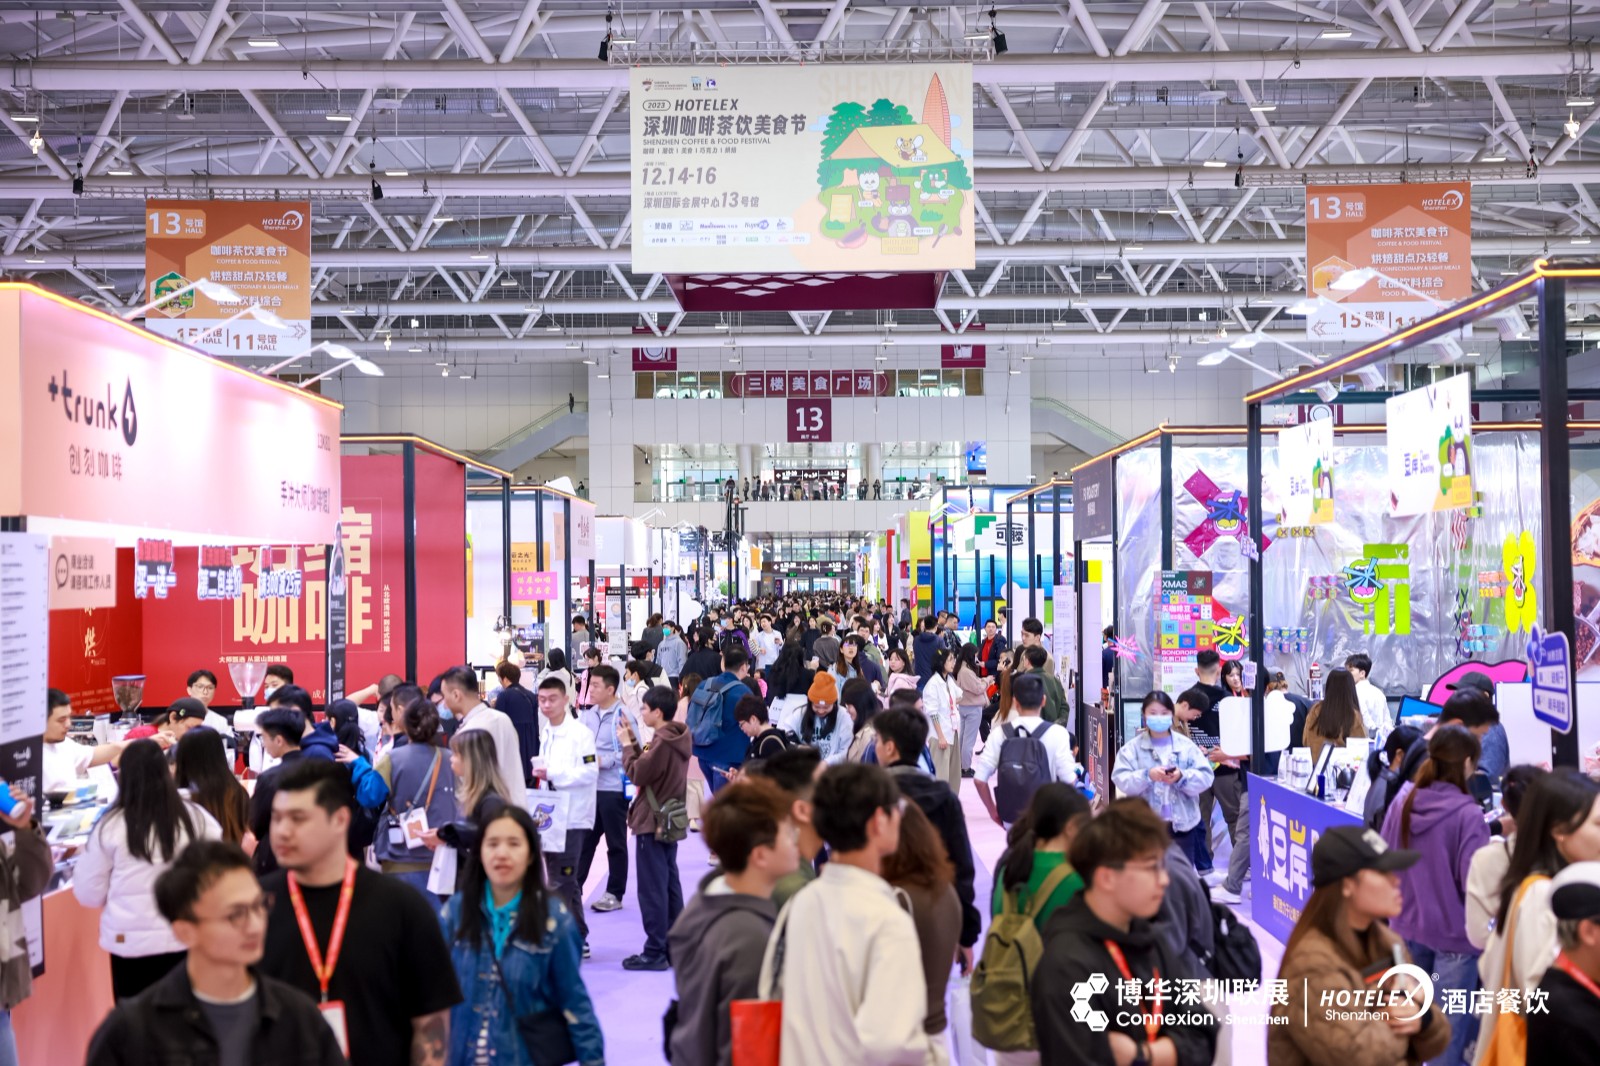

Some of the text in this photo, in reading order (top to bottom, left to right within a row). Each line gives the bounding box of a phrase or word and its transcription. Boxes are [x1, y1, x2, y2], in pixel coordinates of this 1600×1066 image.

[674, 99, 739, 111] HOTELEX
[643, 114, 807, 137] 深圳咖啡茶饮美食节
[741, 137, 771, 145] FESTIVAL
[642, 167, 717, 185] 12.14-16
[643, 192, 760, 208] 深圳国际会展中心13号馆
[1309, 196, 1364, 220] 13 号馆
[1421, 198, 1457, 207] HOTELEX
[149, 212, 204, 235] 13 号馆
[262, 218, 298, 226] HOTELEX
[1370, 226, 1449, 239] 咖啡茶饮美食节
[210, 245, 288, 256] 咖啡茶饮美食节
[1371, 252, 1449, 264] 烘焙甜点及轻餐
[210, 271, 288, 282] 烘焙甜点及轻餐
[1364, 311, 1385, 321] 号馆
[233, 334, 278, 350] 11 号馆
[748, 375, 873, 391] 三楼美食广场
[796, 407, 824, 431] 13
[69, 443, 122, 481] 创刻咖啡
[71, 554, 94, 570] 商业洽谈
[70, 574, 111, 590] 请咨询工作人员
[135, 564, 177, 599] 买一送一
[198, 565, 243, 600] 第二包半价
[1162, 580, 1188, 588] XMAS
[233, 576, 373, 645] 咖啡
[1270, 808, 1309, 901] 豆岸
